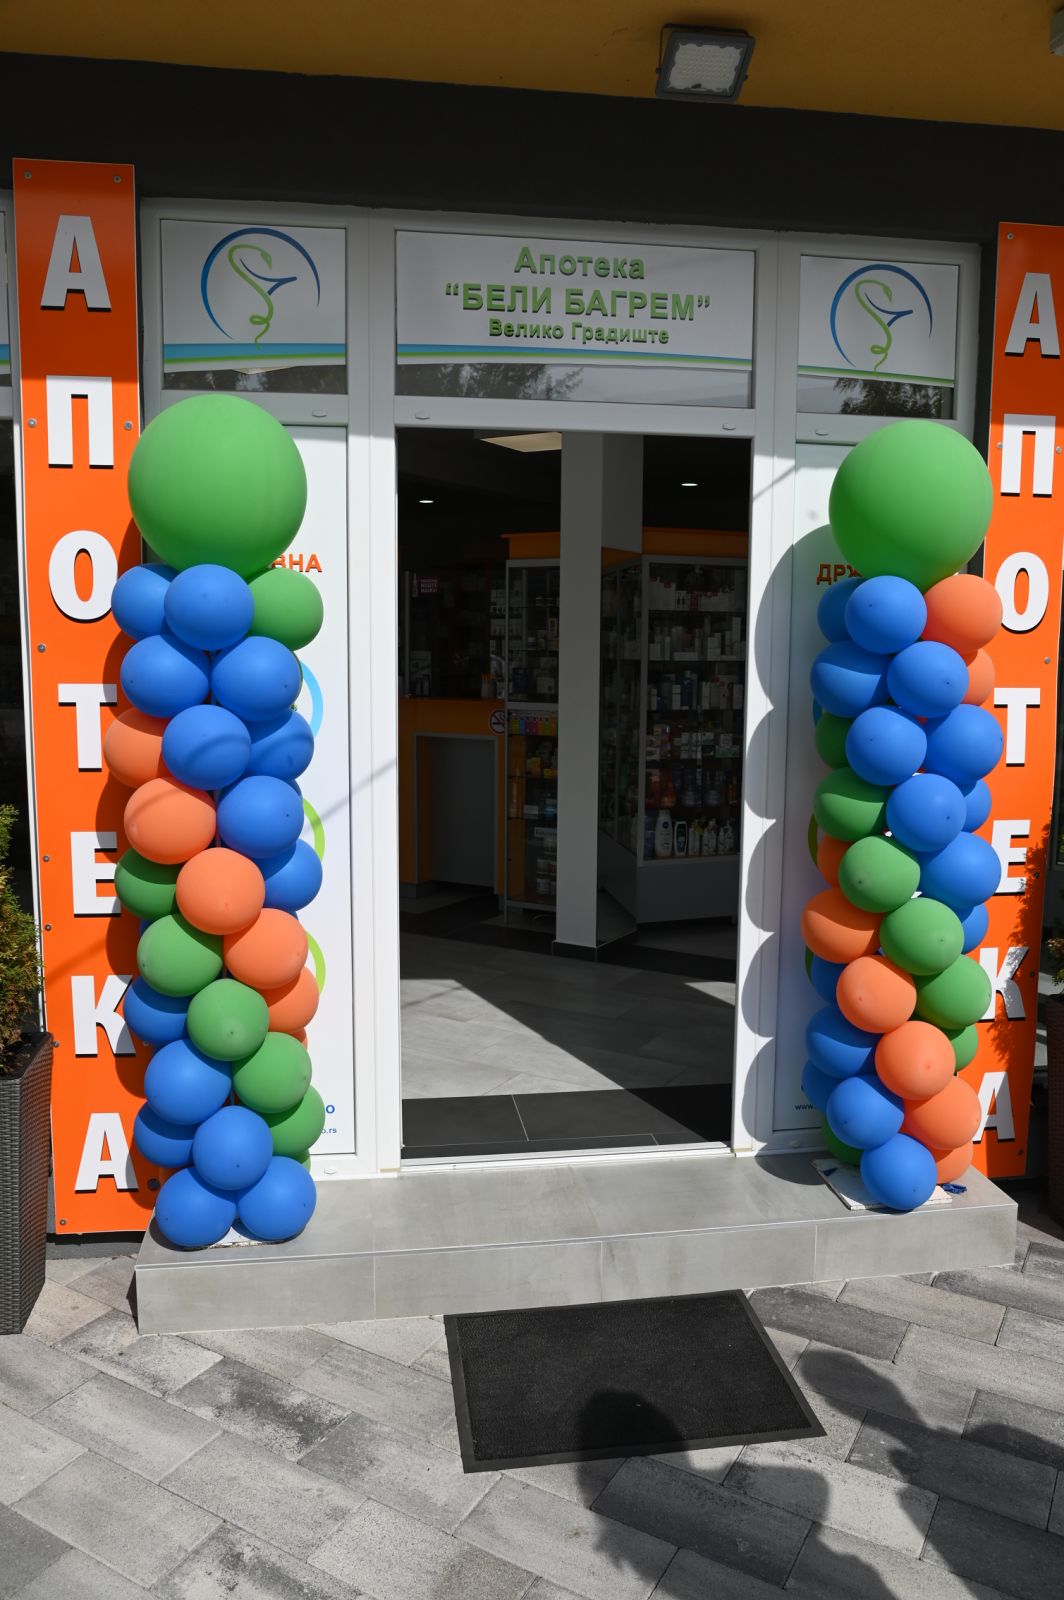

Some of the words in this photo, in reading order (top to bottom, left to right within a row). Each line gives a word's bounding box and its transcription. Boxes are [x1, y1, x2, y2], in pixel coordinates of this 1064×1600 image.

[514, 246, 646, 280] Апотека
[445, 282, 552, 314] “БЕЛИ
[564, 288, 711, 321] БАГРЕМ”
[488, 318, 564, 340] Велико
[571, 322, 670, 345] Градиште
[41, 215, 139, 1193] АПОТЕКА
[972, 272, 1060, 1143] АПОТЕКА
